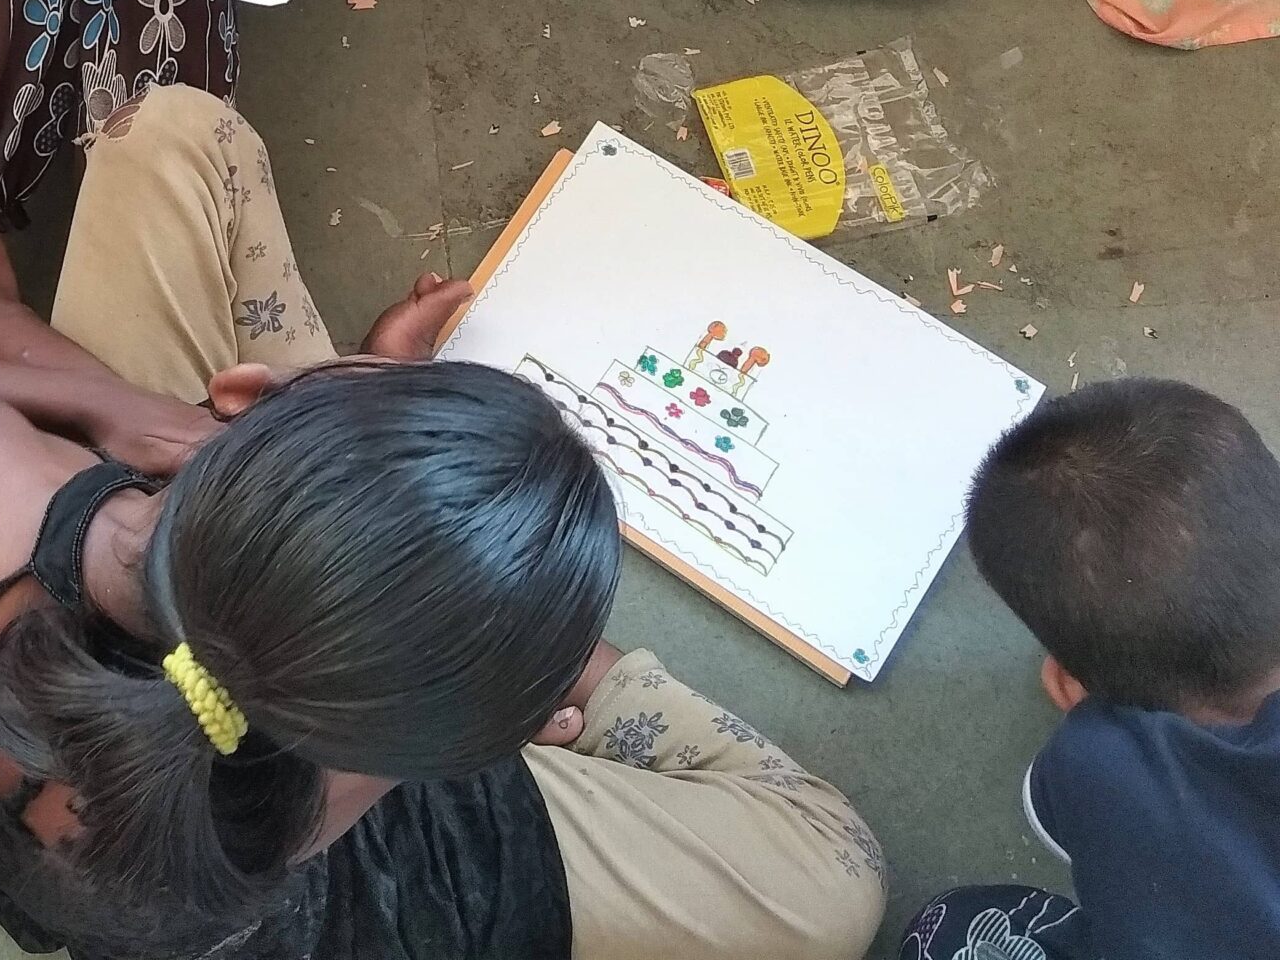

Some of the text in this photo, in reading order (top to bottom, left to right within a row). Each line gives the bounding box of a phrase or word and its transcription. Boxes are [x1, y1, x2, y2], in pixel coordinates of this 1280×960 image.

[784, 117, 815, 183] 12 WATER COLOR PENS
[794, 110, 837, 186] DINOO
[873, 167, 898, 215] ColorPik
